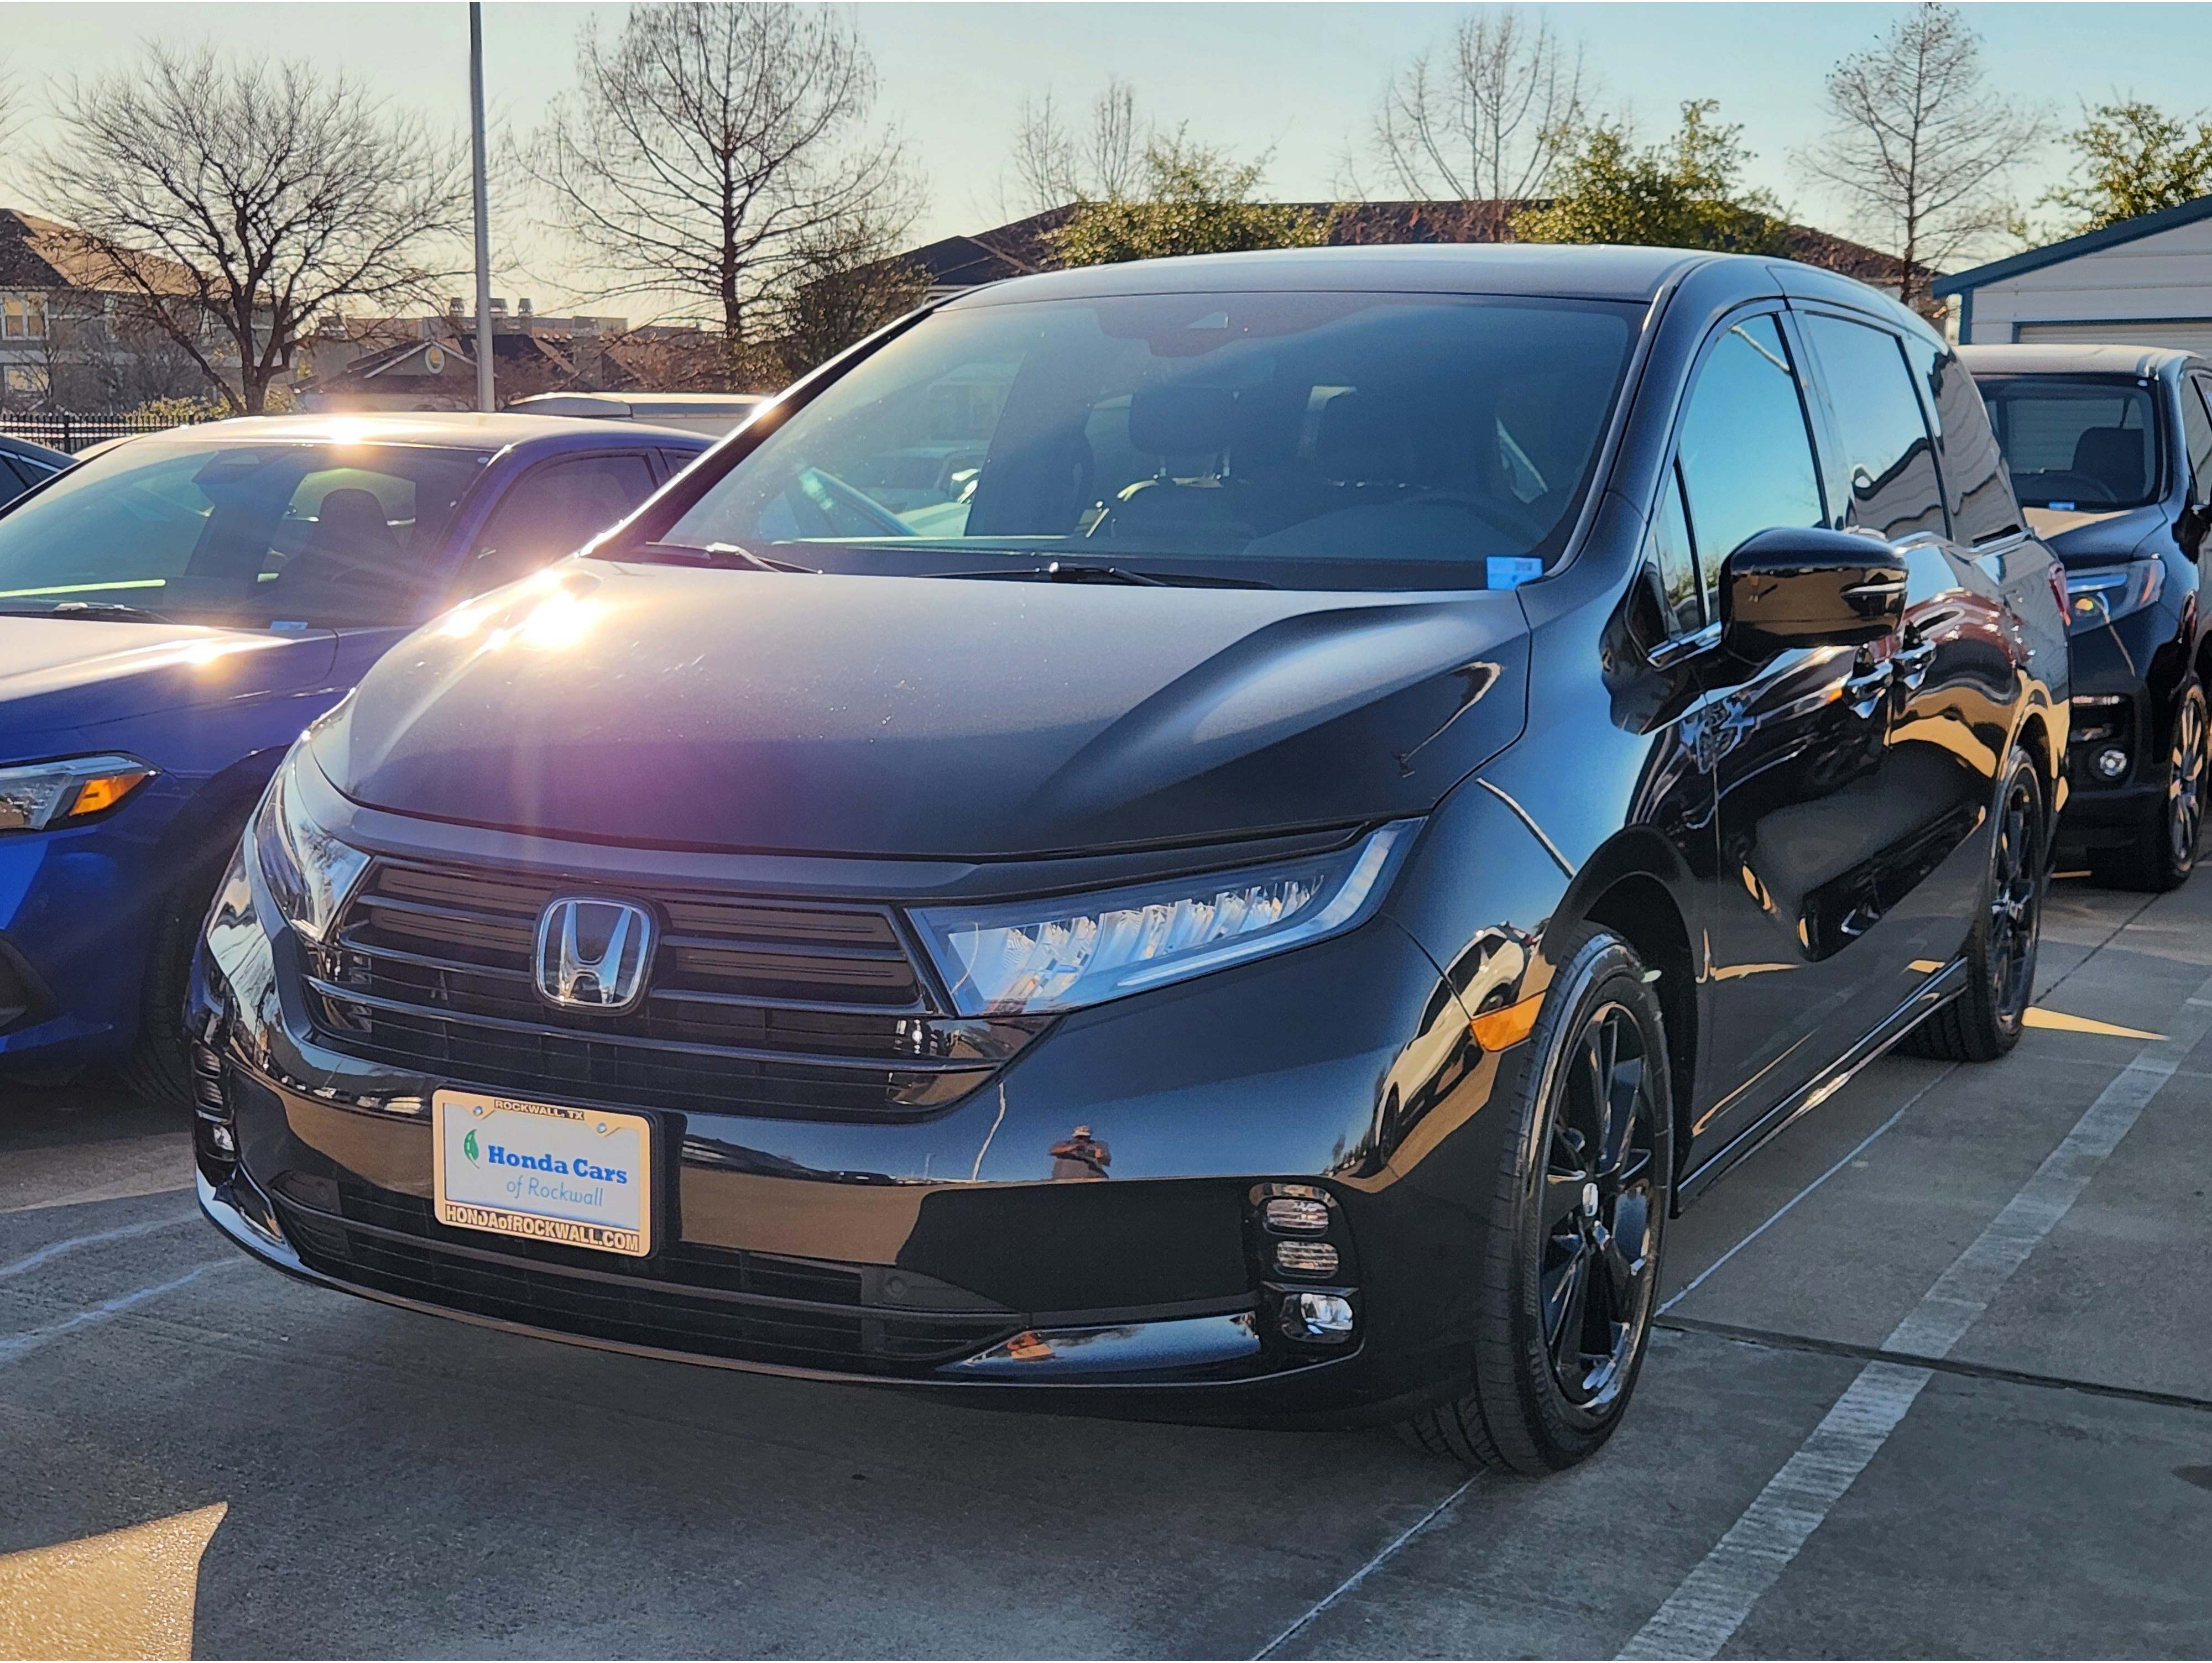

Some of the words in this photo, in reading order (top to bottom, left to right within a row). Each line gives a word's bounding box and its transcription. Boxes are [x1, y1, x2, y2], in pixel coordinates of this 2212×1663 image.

[567, 1110, 583, 1120] TX
[488, 1145, 568, 1175] Honda
[573, 1158, 628, 1184] Cars
[506, 1175, 524, 1199] of
[528, 1176, 604, 1206] Rockwall
